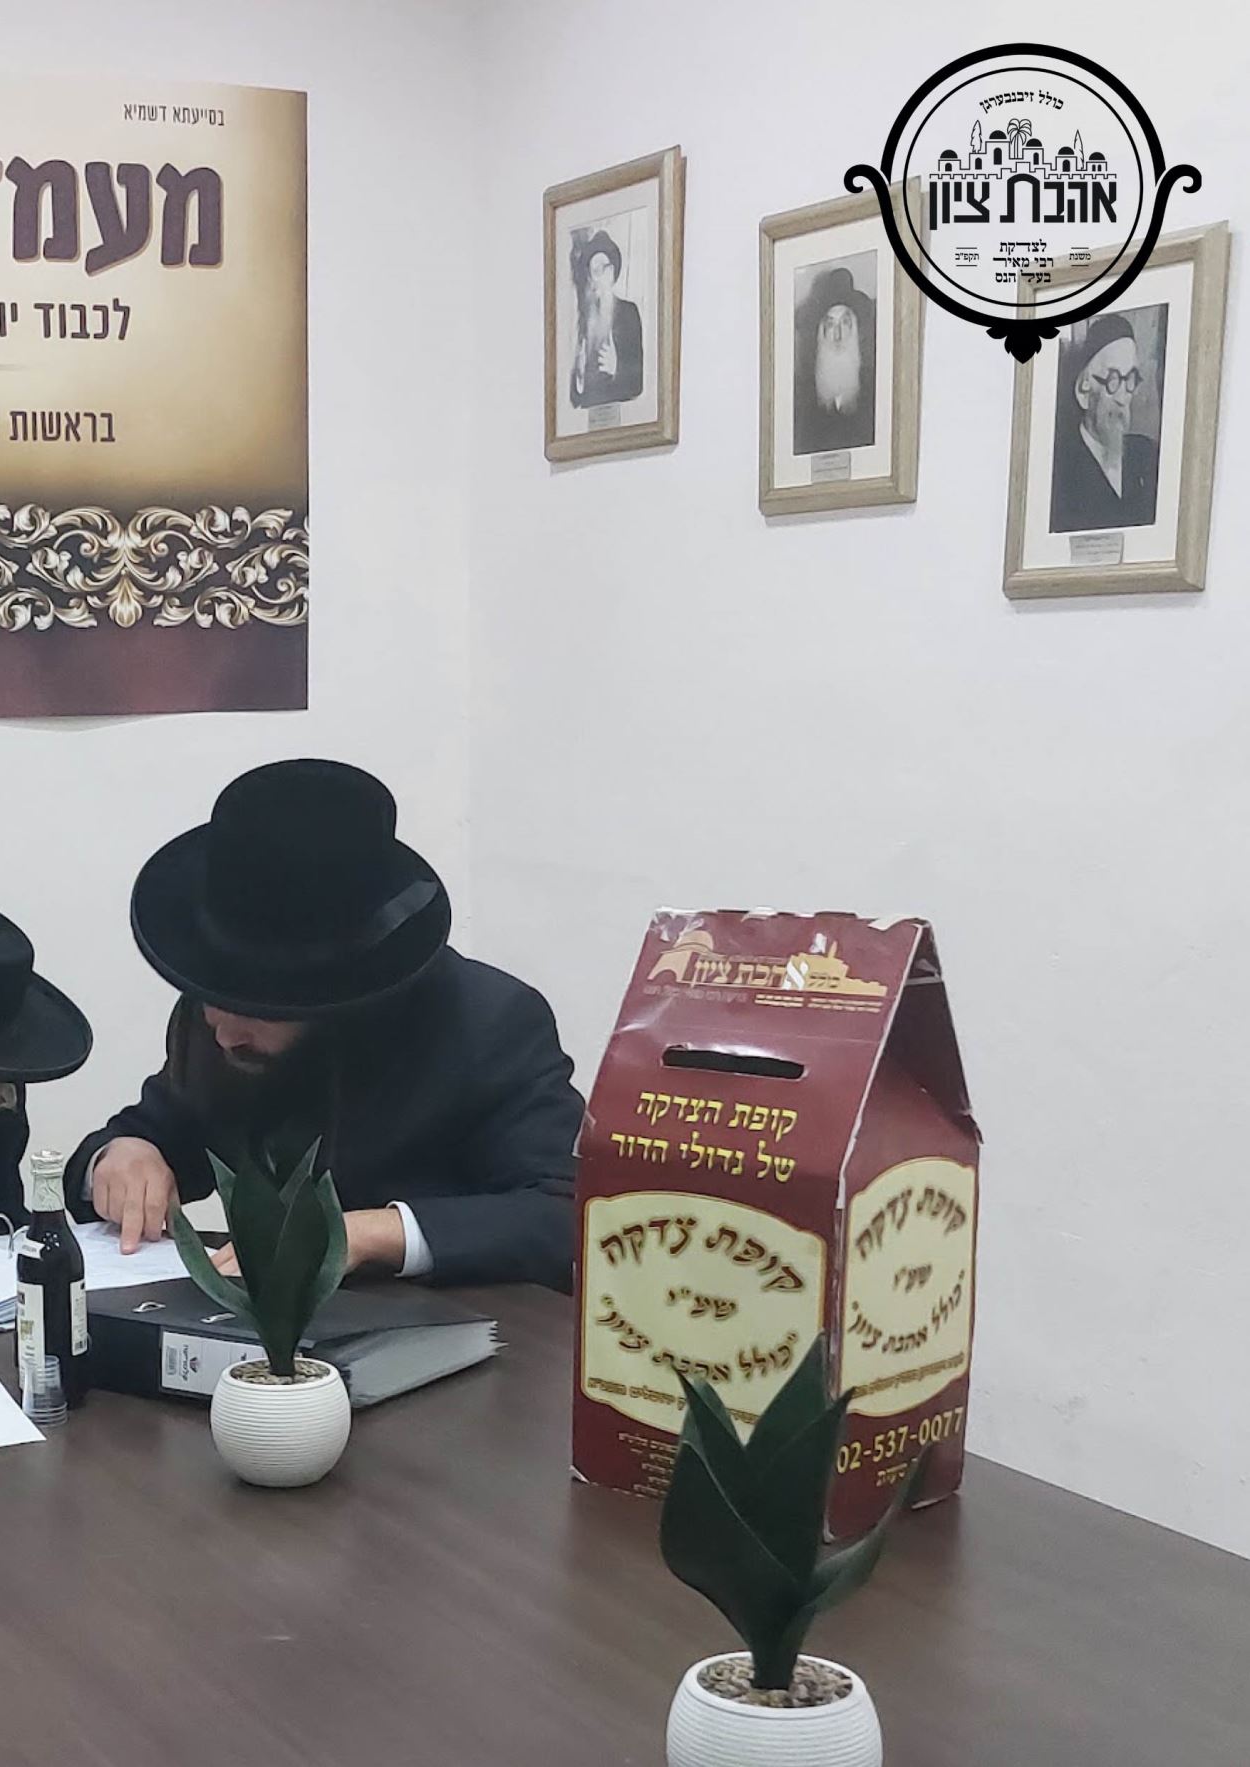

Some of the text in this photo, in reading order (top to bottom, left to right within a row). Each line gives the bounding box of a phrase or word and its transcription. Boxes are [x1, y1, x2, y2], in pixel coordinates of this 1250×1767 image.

[123, 103, 225, 126] בסייעתא דשמיא
[33, 298, 131, 341] לכבוד
[10, 411, 116, 443] בראשות
[636, 1091, 798, 1143] קופת הצדקה
[610, 1132, 669, 1163] הדור
[756, 1140, 796, 1182] של
[855, 1187, 967, 1261] קופת צדקה
[599, 1217, 804, 1292] קופת צדקה
[836, 1406, 964, 1474] 02-537-0077
